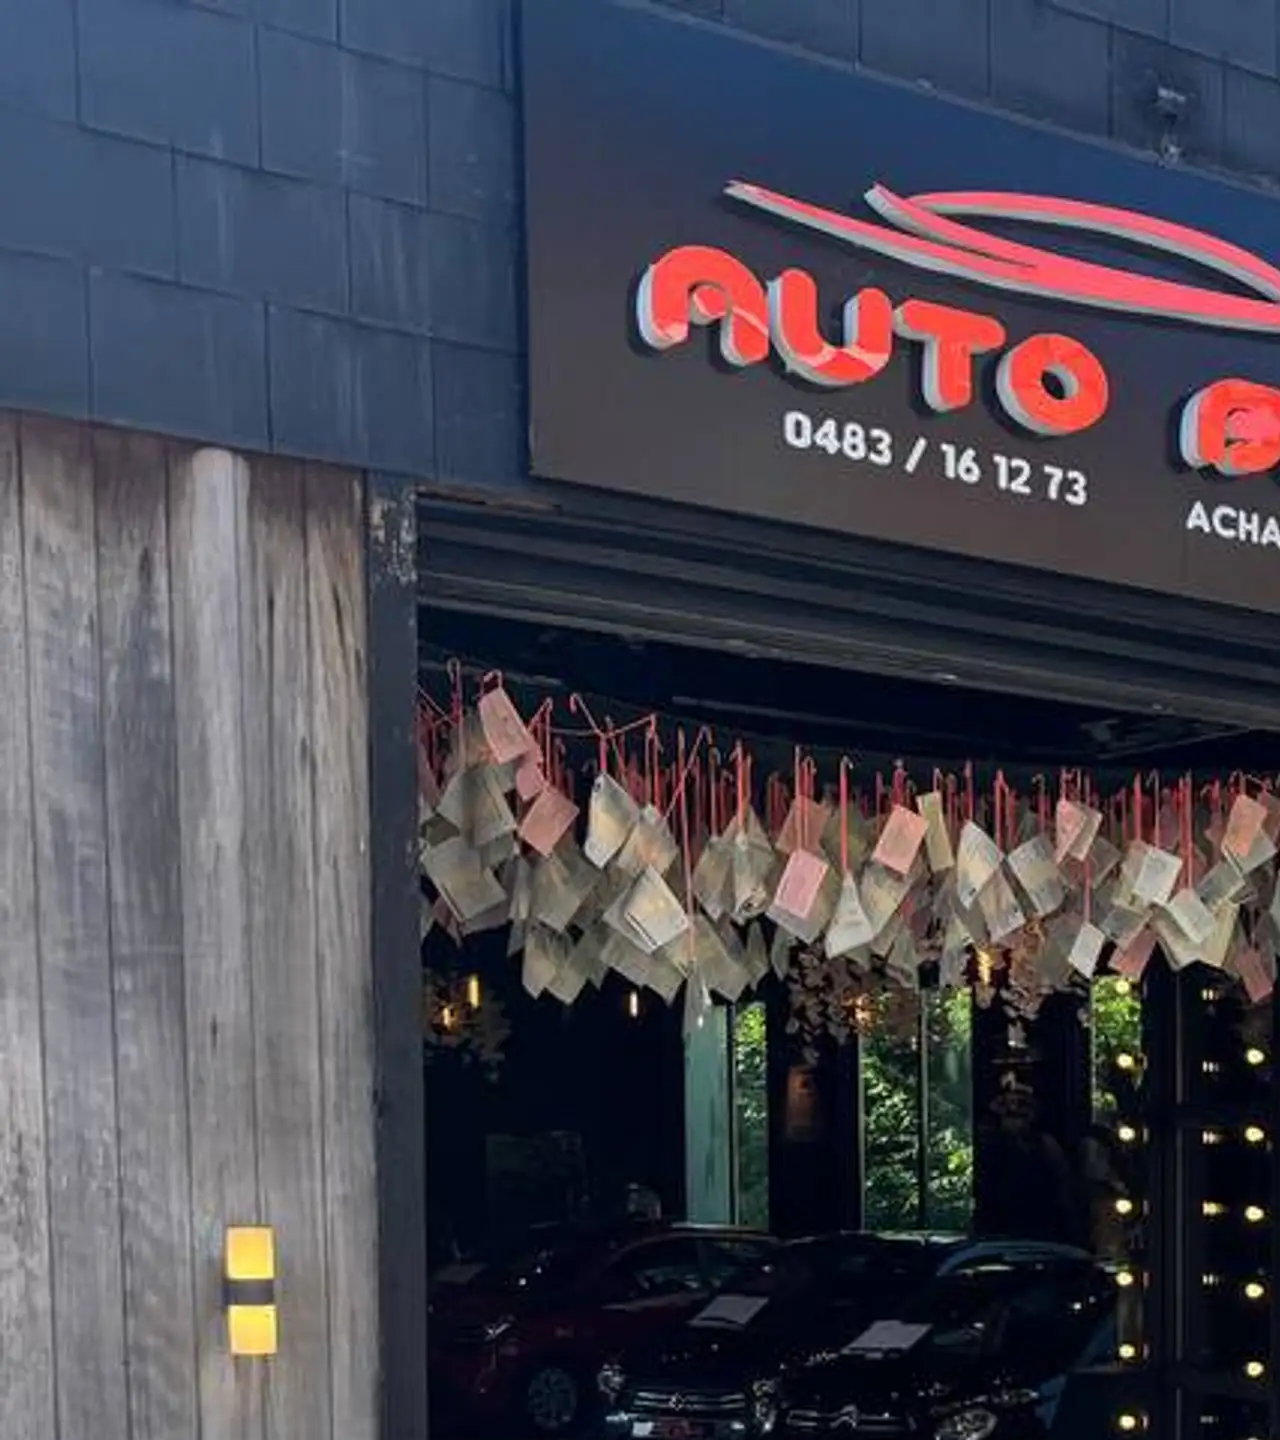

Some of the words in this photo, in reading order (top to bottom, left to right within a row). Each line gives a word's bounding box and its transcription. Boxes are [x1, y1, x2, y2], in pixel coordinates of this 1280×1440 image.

[637, 245, 1108, 436] AUTO
[784, 411, 892, 466] 0483
[905, 436, 928, 473] /
[941, 442, 981, 484] 16
[993, 453, 1032, 495] 12
[1043, 465, 1087, 506] 73
